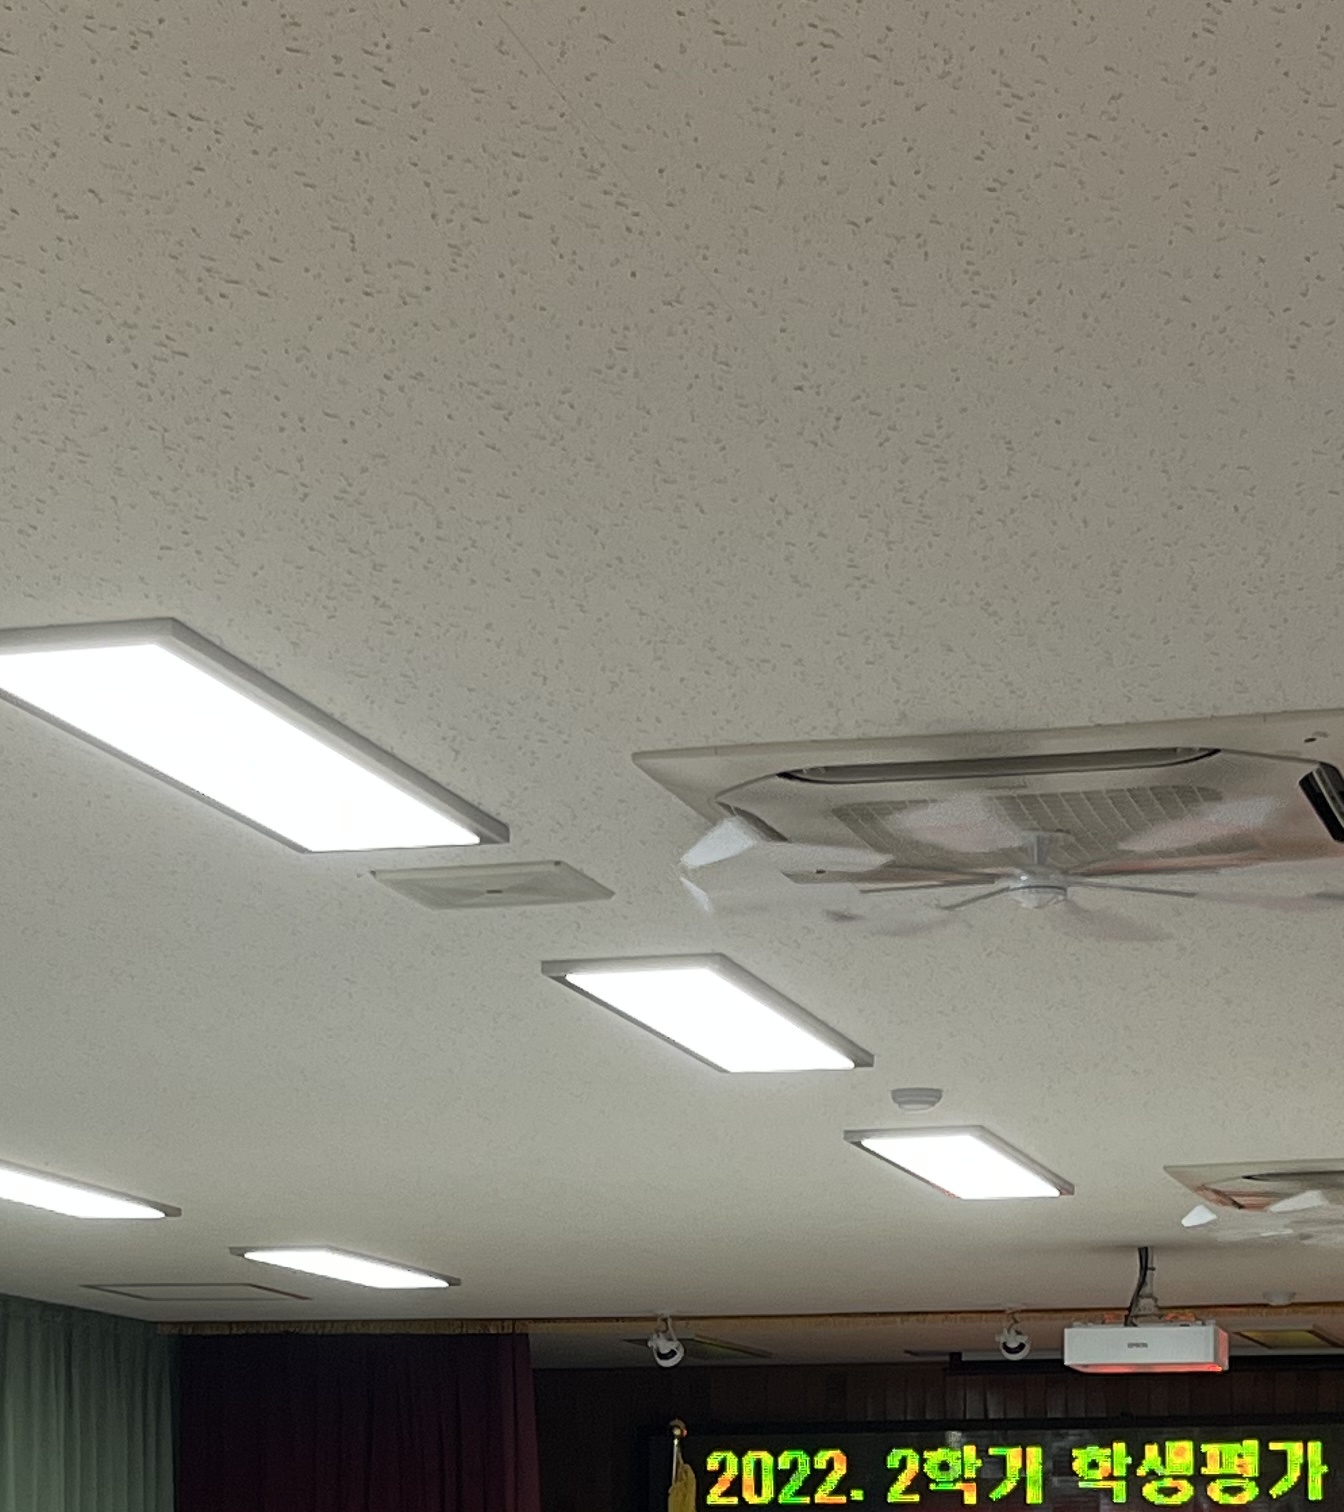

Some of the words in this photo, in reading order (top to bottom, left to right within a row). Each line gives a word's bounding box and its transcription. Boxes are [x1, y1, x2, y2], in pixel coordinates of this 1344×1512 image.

[706, 1449, 864, 1504] 2022.
[886, 1444, 1043, 1504] 2학기
[1071, 1439, 1328, 1504] 학생평가
